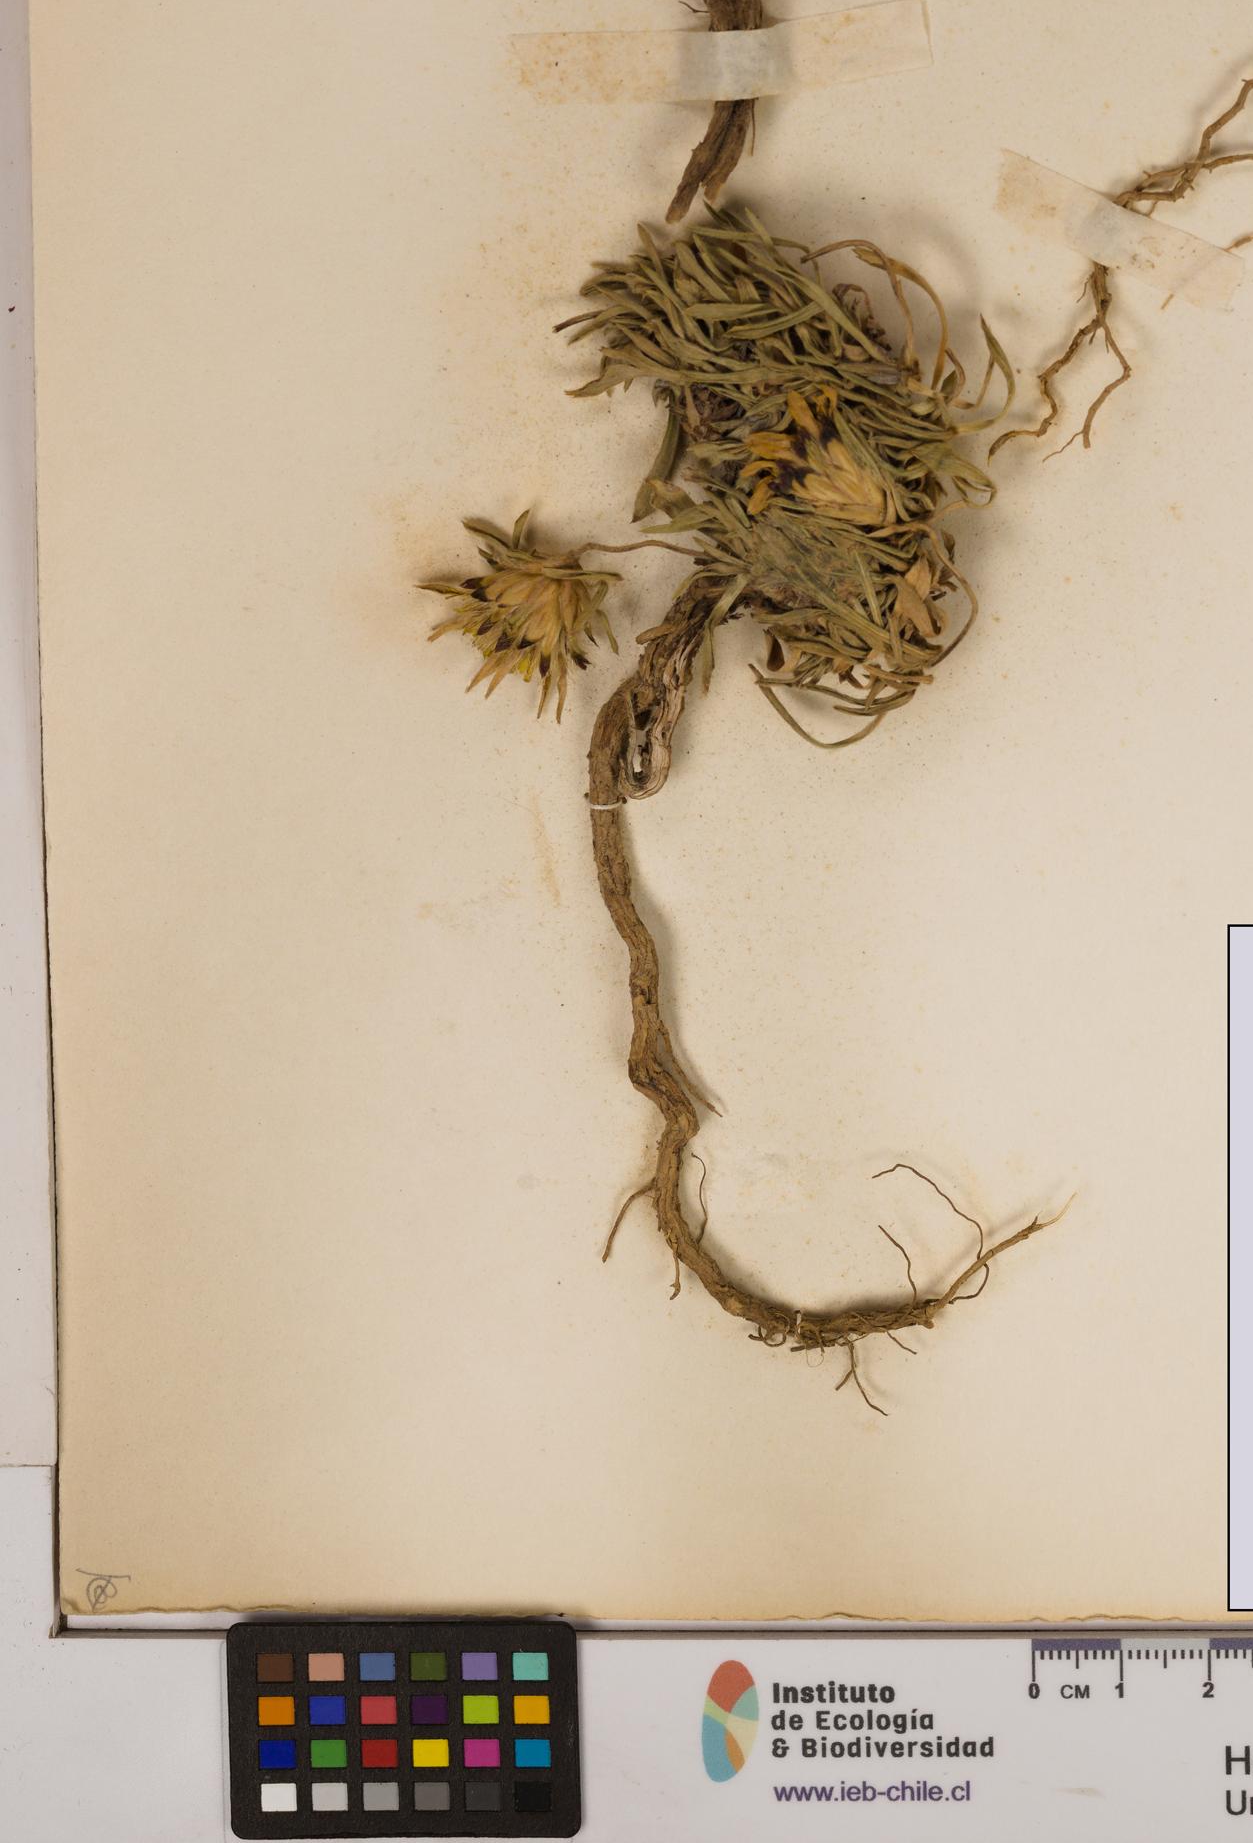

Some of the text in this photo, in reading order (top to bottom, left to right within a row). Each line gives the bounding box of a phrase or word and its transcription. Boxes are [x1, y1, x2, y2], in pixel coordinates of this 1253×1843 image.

[772, 1680, 896, 1704] Instituto
[1028, 1682, 1041, 1700] 0
[1060, 1684, 1090, 1700] CM
[1114, 1681, 1125, 1699] 1
[1202, 1681, 1215, 1699] 2
[770, 1708, 934, 1735] de Ecología
[771, 1735, 994, 1759] & Biodiversidad
[773, 1780, 971, 1802] www.ieb-chile.cl
